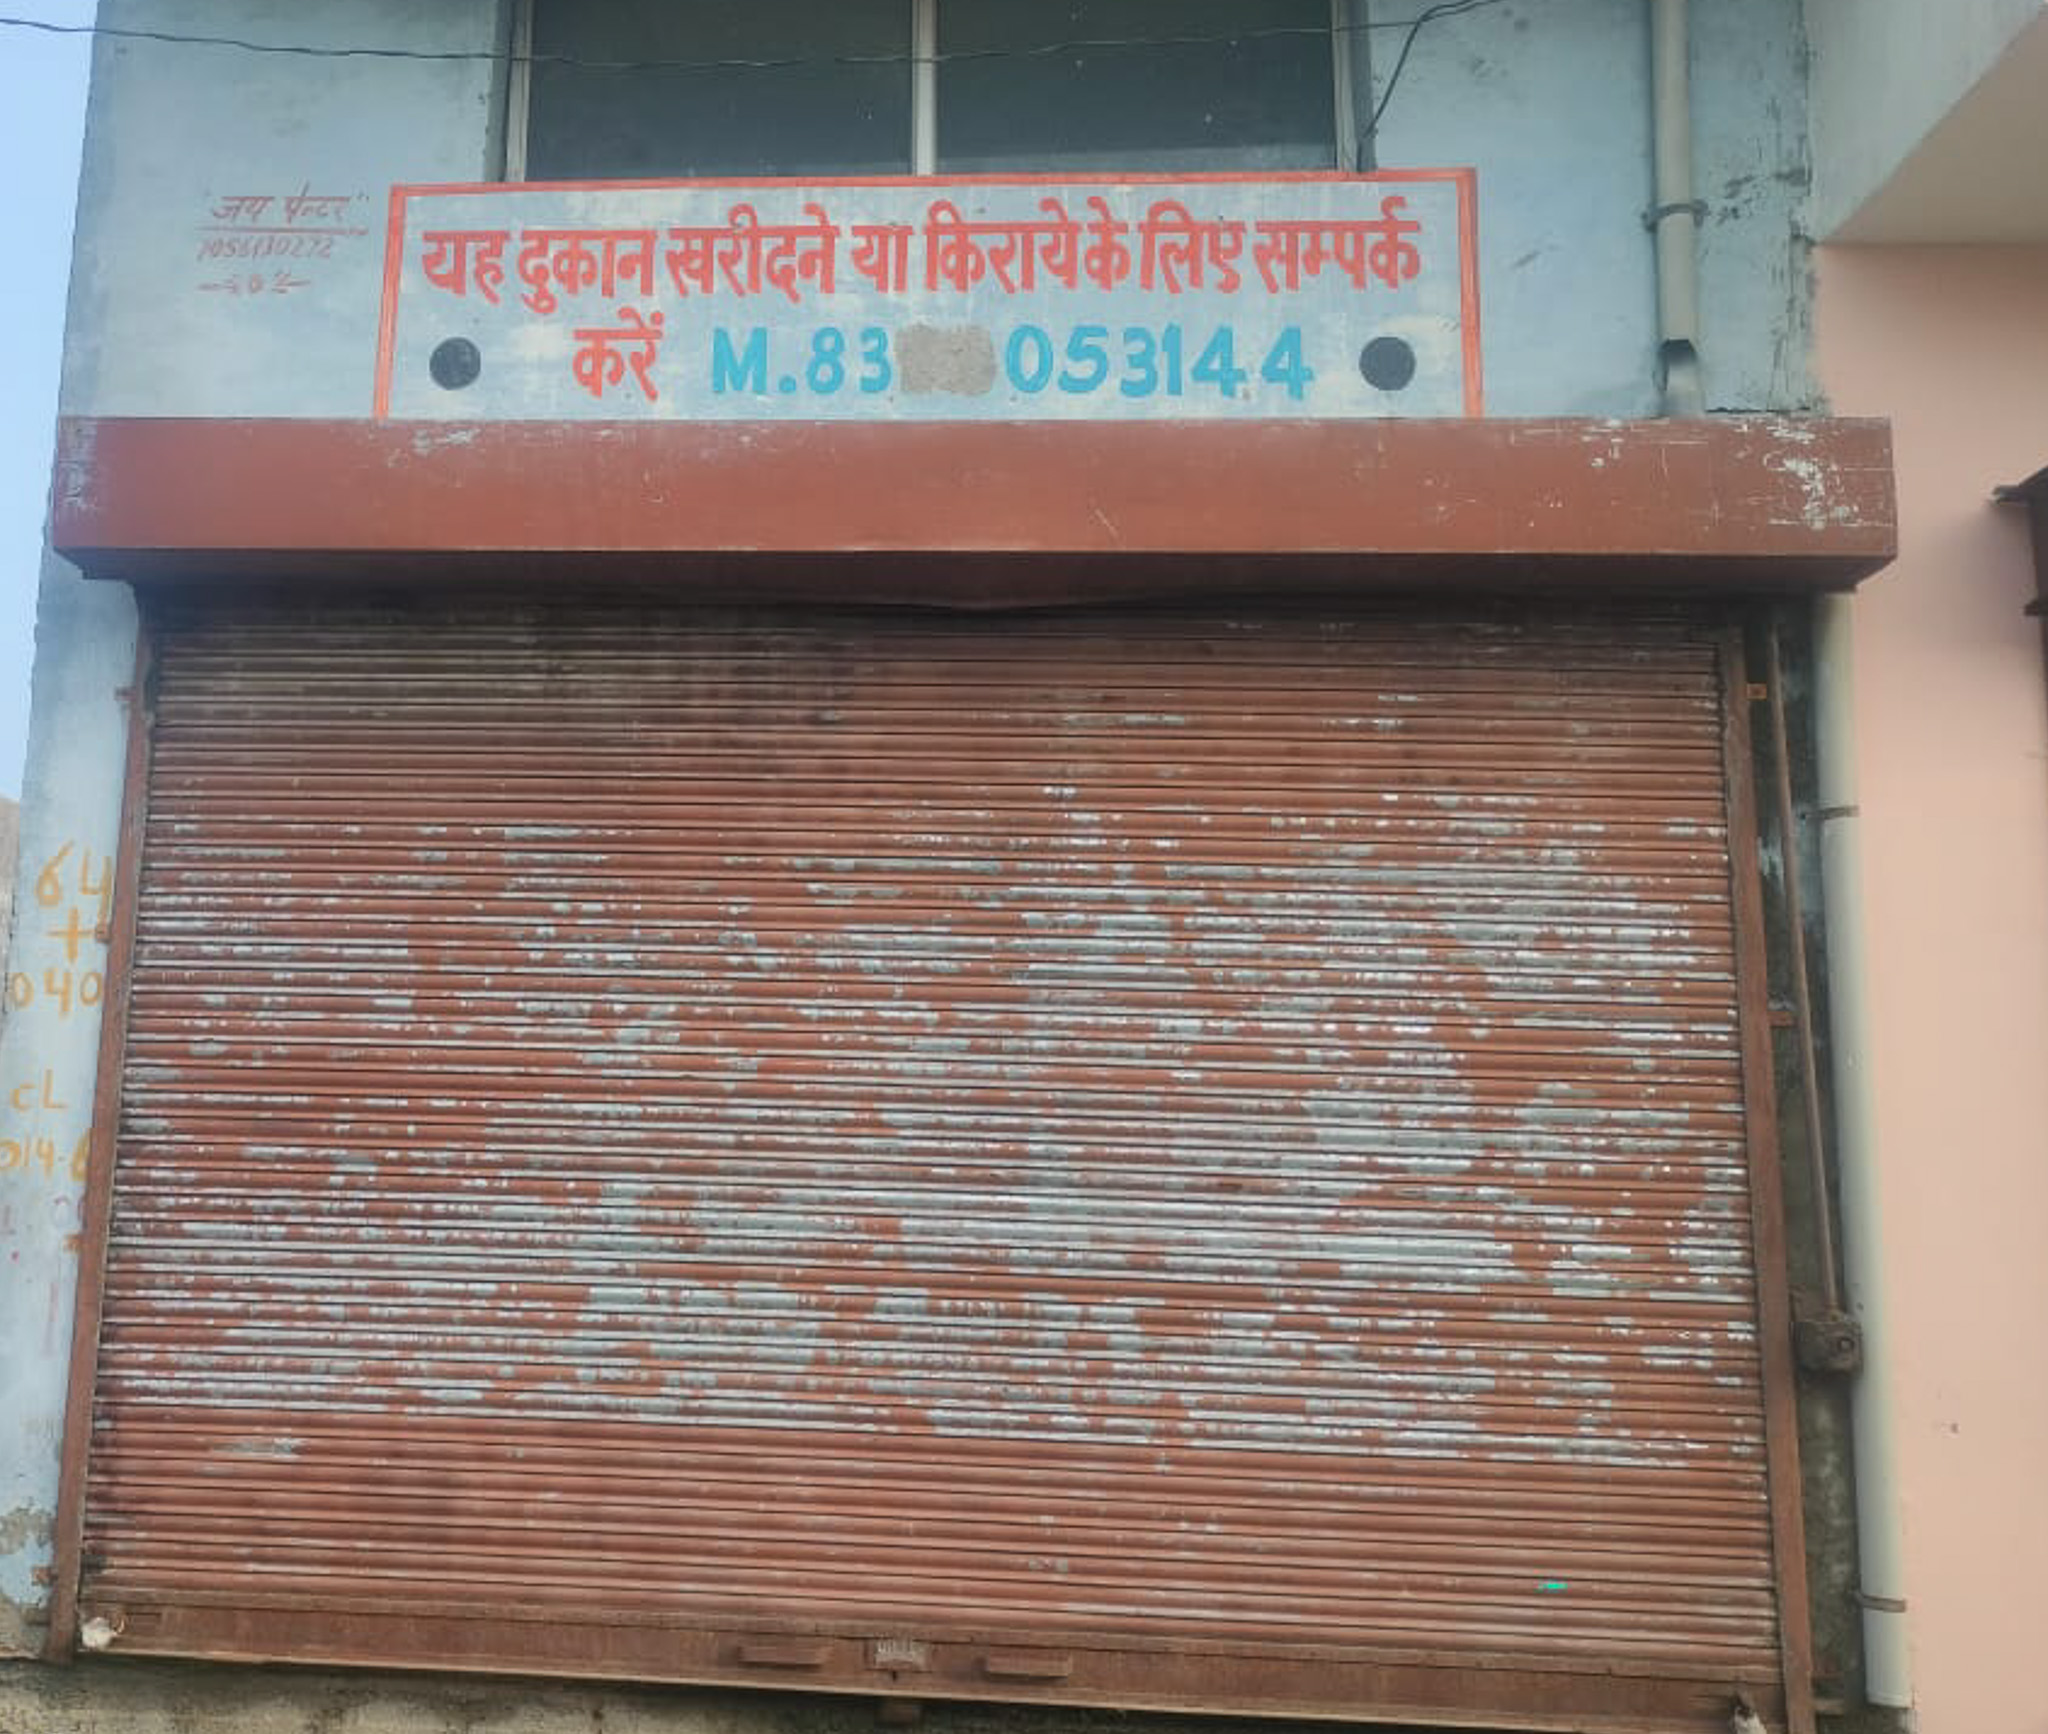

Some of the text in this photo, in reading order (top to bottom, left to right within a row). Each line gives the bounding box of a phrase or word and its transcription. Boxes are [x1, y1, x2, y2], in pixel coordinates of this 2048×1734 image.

[422, 230, 511, 303] यह
[517, 229, 656, 314] दुकान
[665, 203, 840, 303] खरीदने
[850, 225, 913, 294] या
[1138, 200, 1248, 294] लिए
[1252, 196, 1421, 294] सम्पर्क
[572, 306, 664, 402] करें
